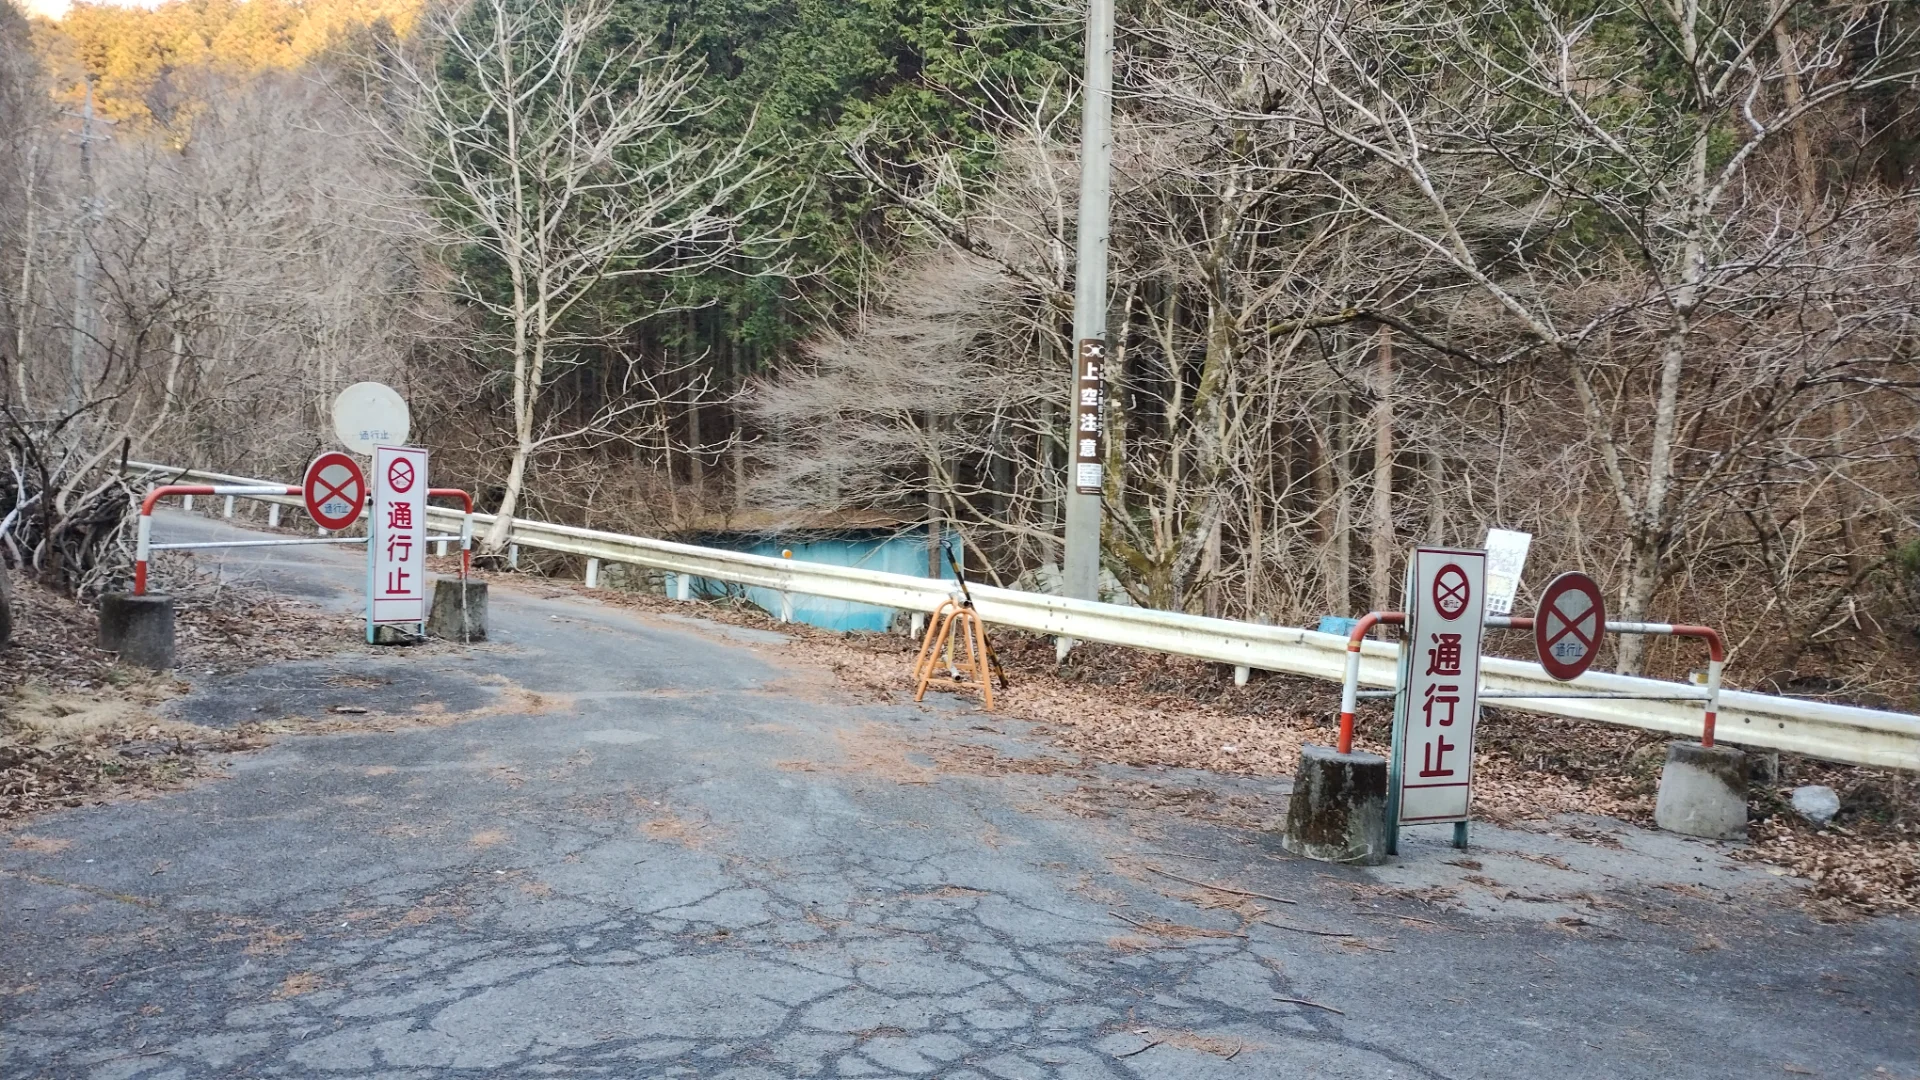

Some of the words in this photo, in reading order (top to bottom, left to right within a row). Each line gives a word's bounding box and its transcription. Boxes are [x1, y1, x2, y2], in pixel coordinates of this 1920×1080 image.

[359, 429, 390, 440] 通行止
[1079, 361, 1098, 457] 上空注意
[324, 503, 350, 514] 通行止
[386, 501, 413, 595] 通行止
[1555, 643, 1583, 657] 通行止
[1419, 633, 1462, 778] 通行止
